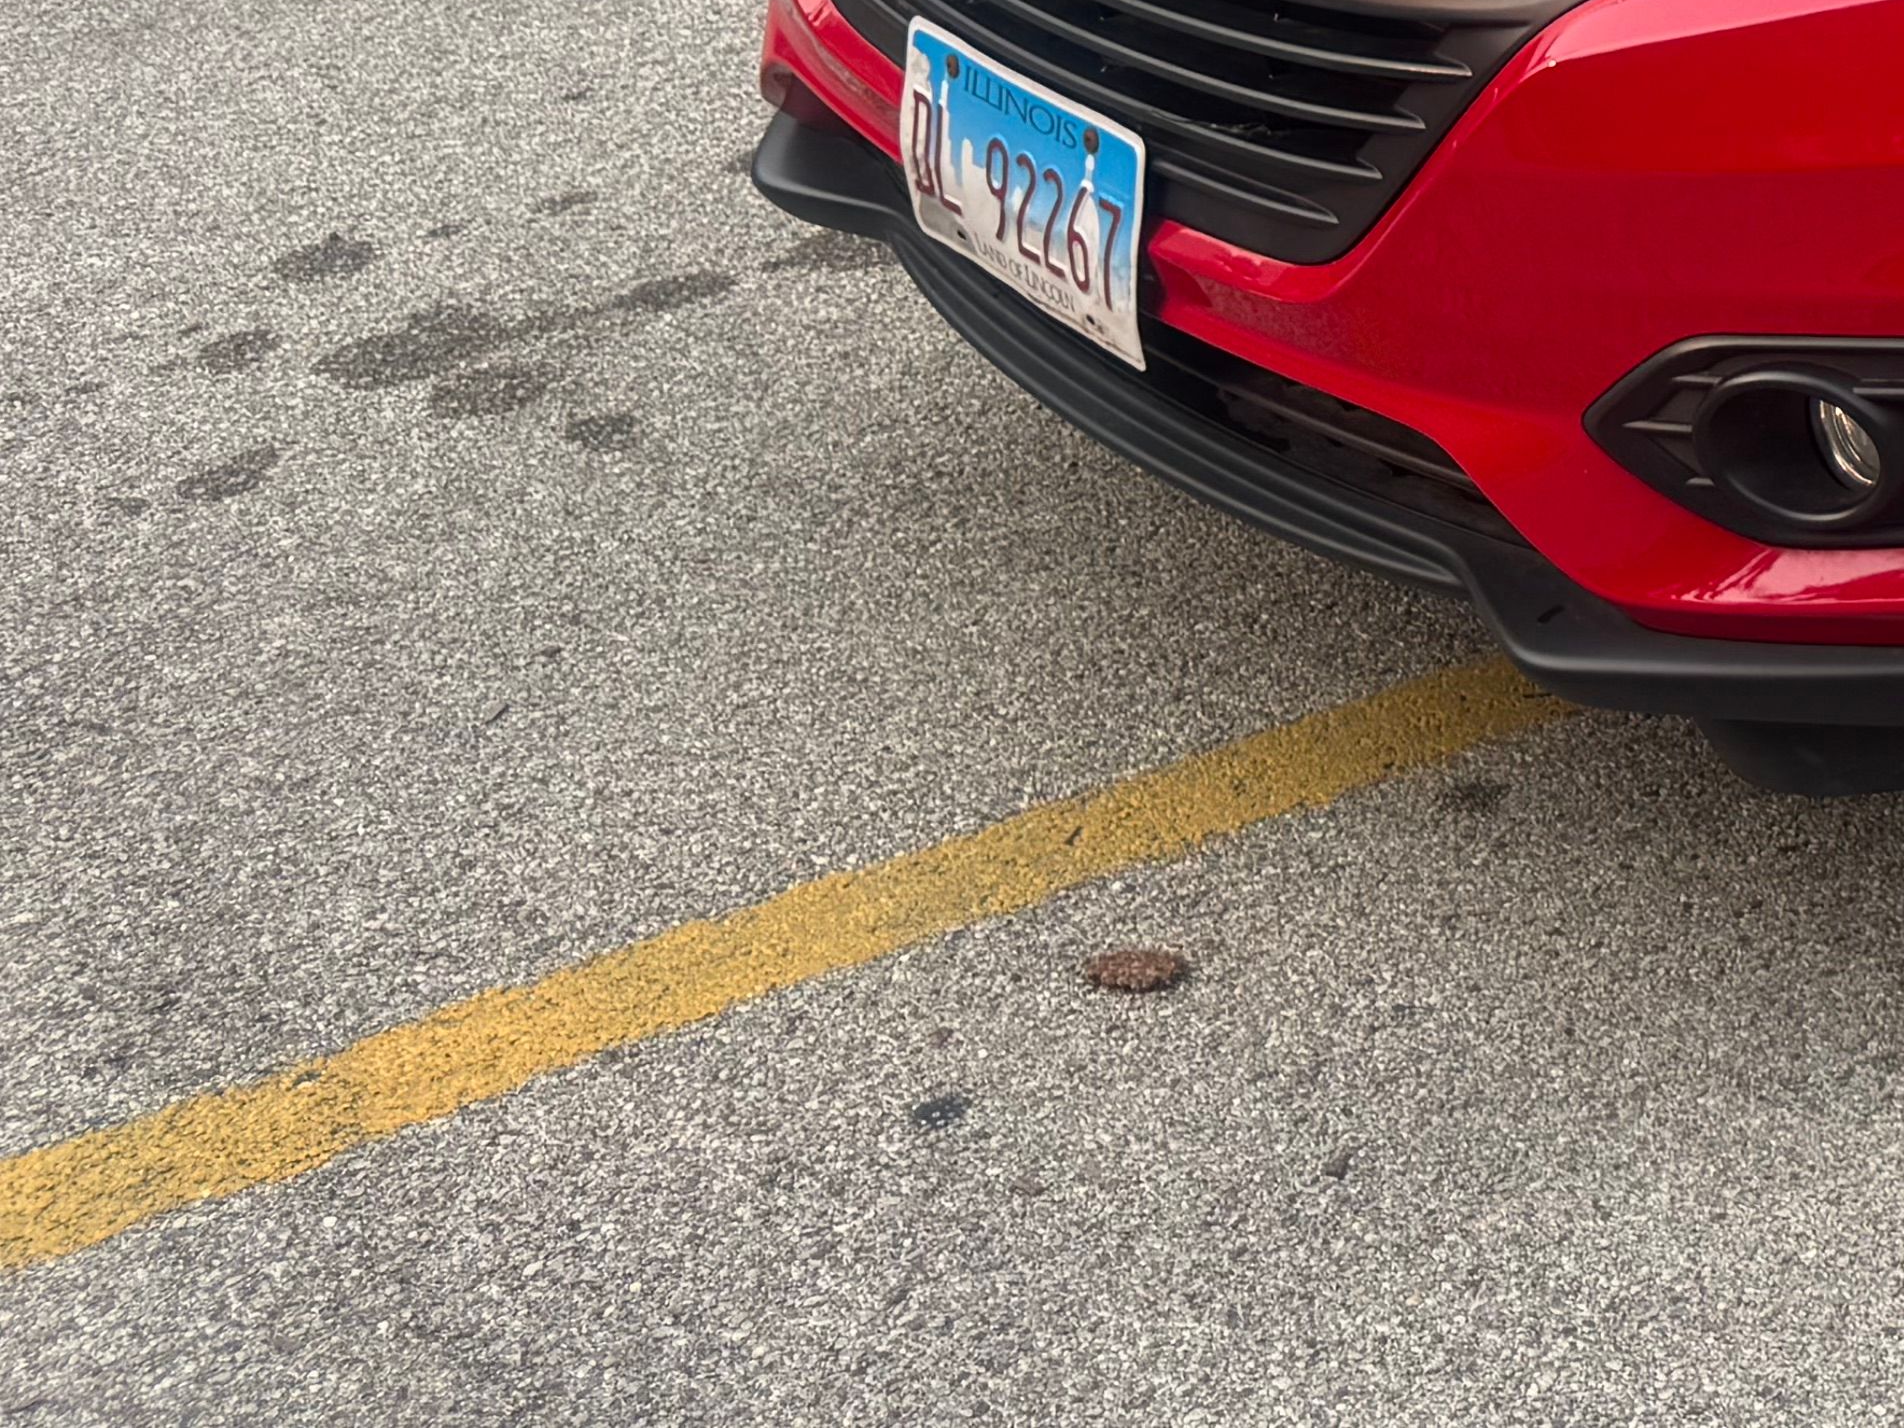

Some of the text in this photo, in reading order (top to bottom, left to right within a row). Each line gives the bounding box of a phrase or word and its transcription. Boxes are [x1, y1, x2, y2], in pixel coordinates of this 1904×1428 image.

[963, 64, 1078, 150] ILLINOIS
[986, 137, 1122, 312] 92267
[1024, 263, 1076, 313] LINCOLN
